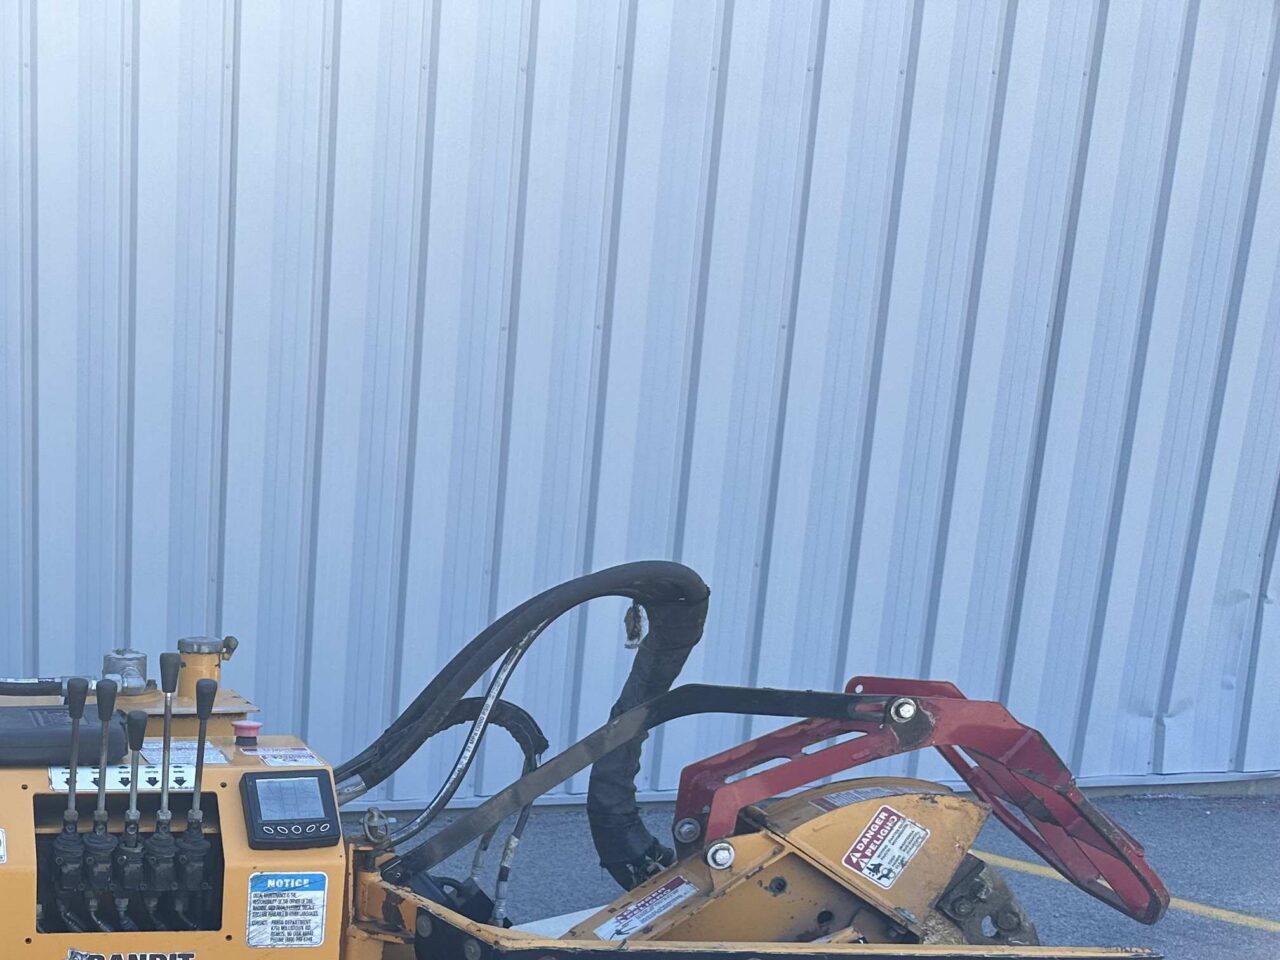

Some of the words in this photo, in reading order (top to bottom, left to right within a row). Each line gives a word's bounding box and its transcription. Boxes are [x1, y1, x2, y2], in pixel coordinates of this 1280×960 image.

[856, 811, 889, 851] DANGER
[865, 815, 898, 856] PELIGRO
[267, 879, 310, 888] NOTICE
